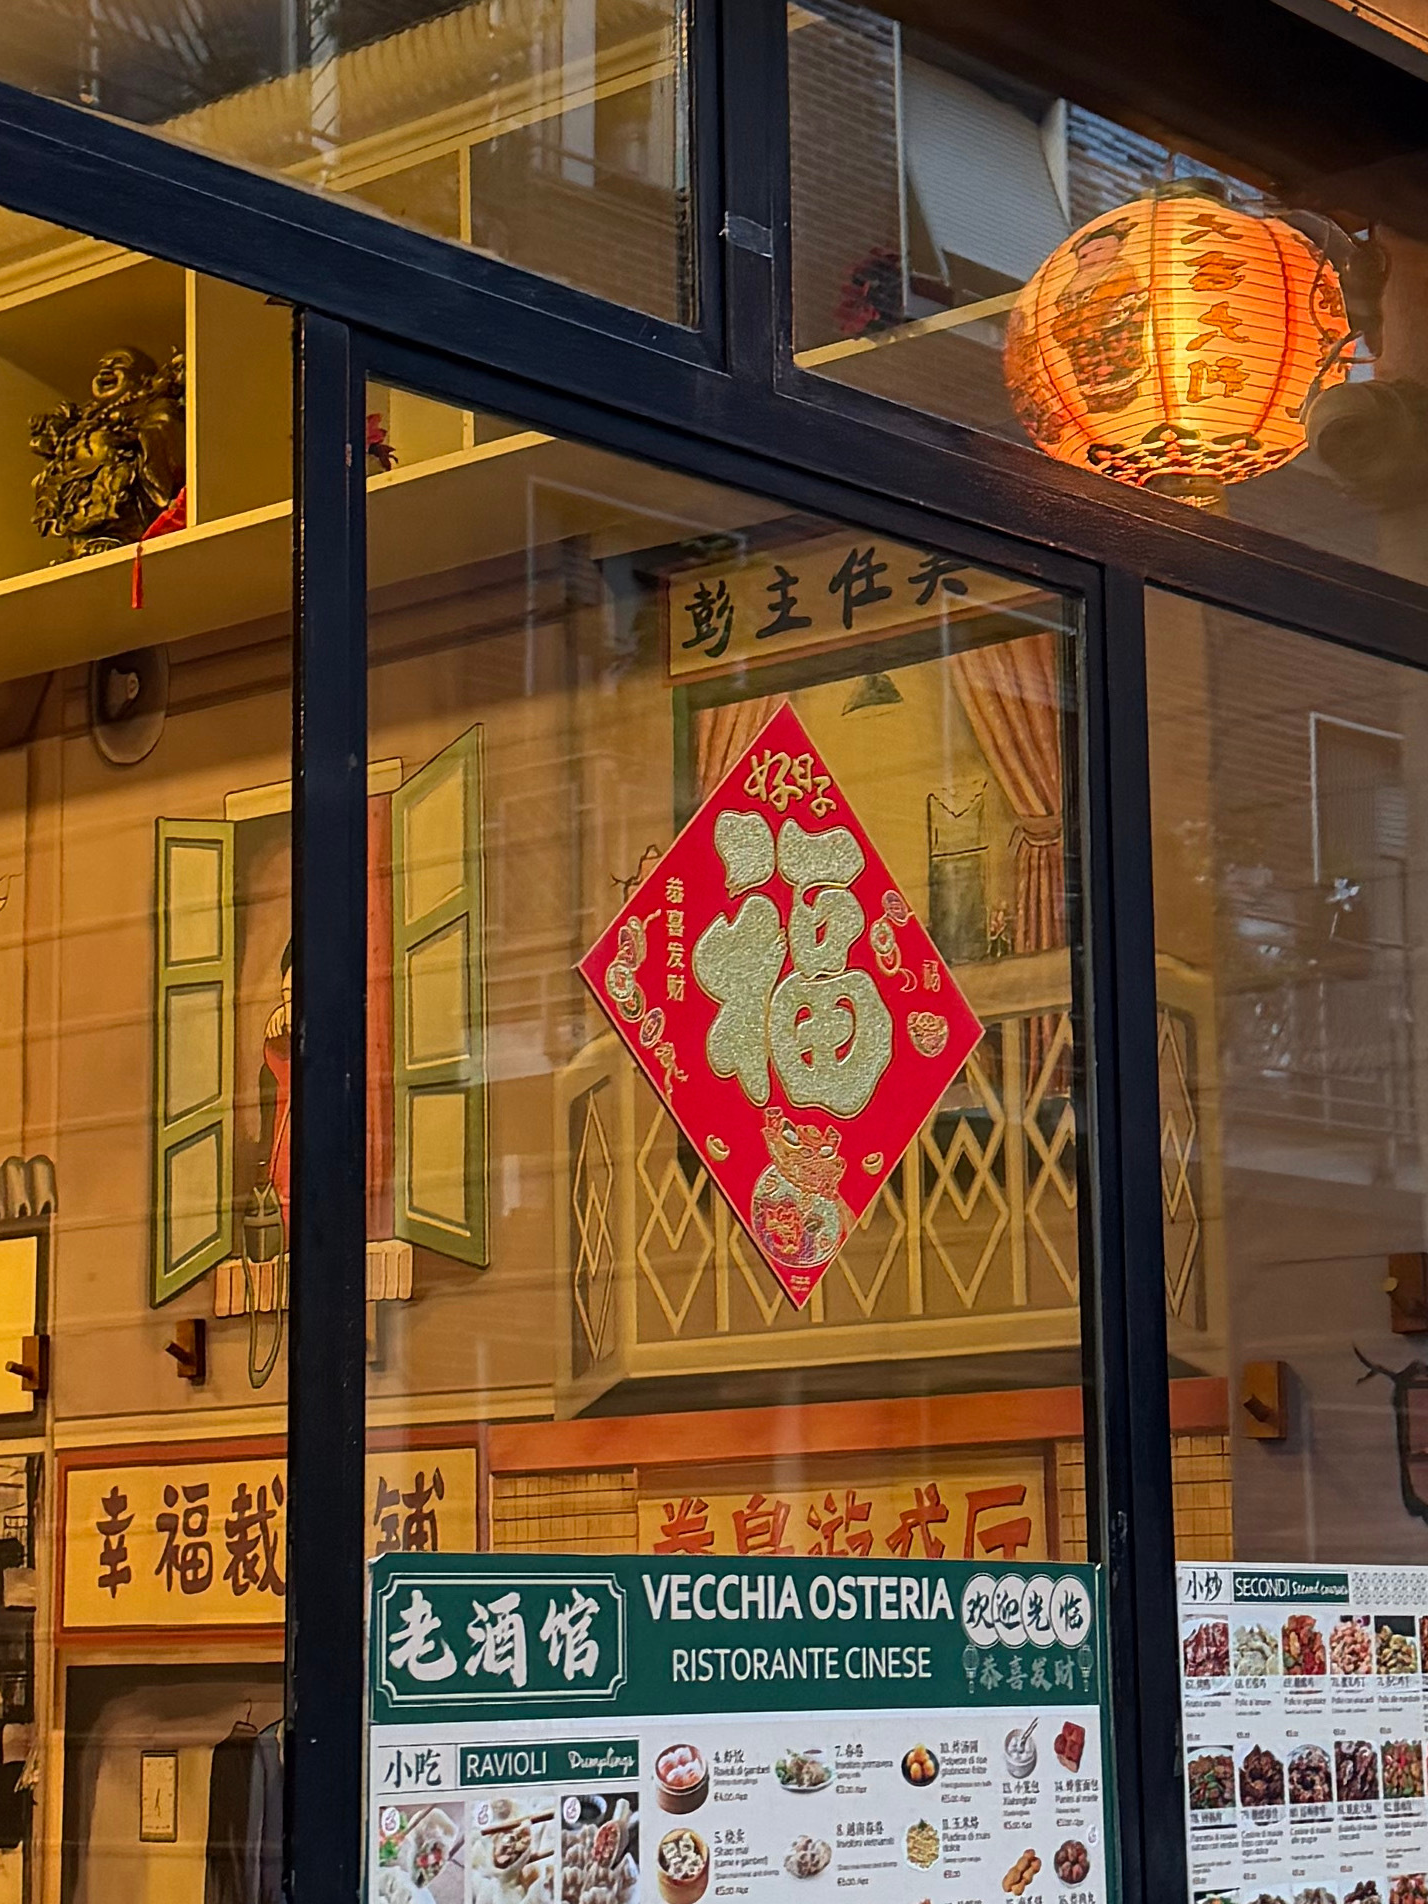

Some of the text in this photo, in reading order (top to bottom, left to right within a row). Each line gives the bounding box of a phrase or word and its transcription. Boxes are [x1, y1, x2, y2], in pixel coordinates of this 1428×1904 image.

[665, 876, 685, 1003] 恭喜发财
[691, 808, 895, 1121] 福
[642, 1573, 954, 1621] VECCHIA OSTERIA
[1185, 1571, 1223, 1601] 小炒
[1236, 1578, 1290, 1596] SECONDI
[966, 1589, 1084, 1632] 欢迎光临
[387, 1587, 602, 1690] 老酒馆
[672, 1646, 932, 1682] RISTORANTE CINESE
[980, 1654, 1075, 1691] 恭喜发财
[384, 1748, 442, 1788] 小吃
[466, 1748, 635, 1778] RAVIOLI Dumplings
